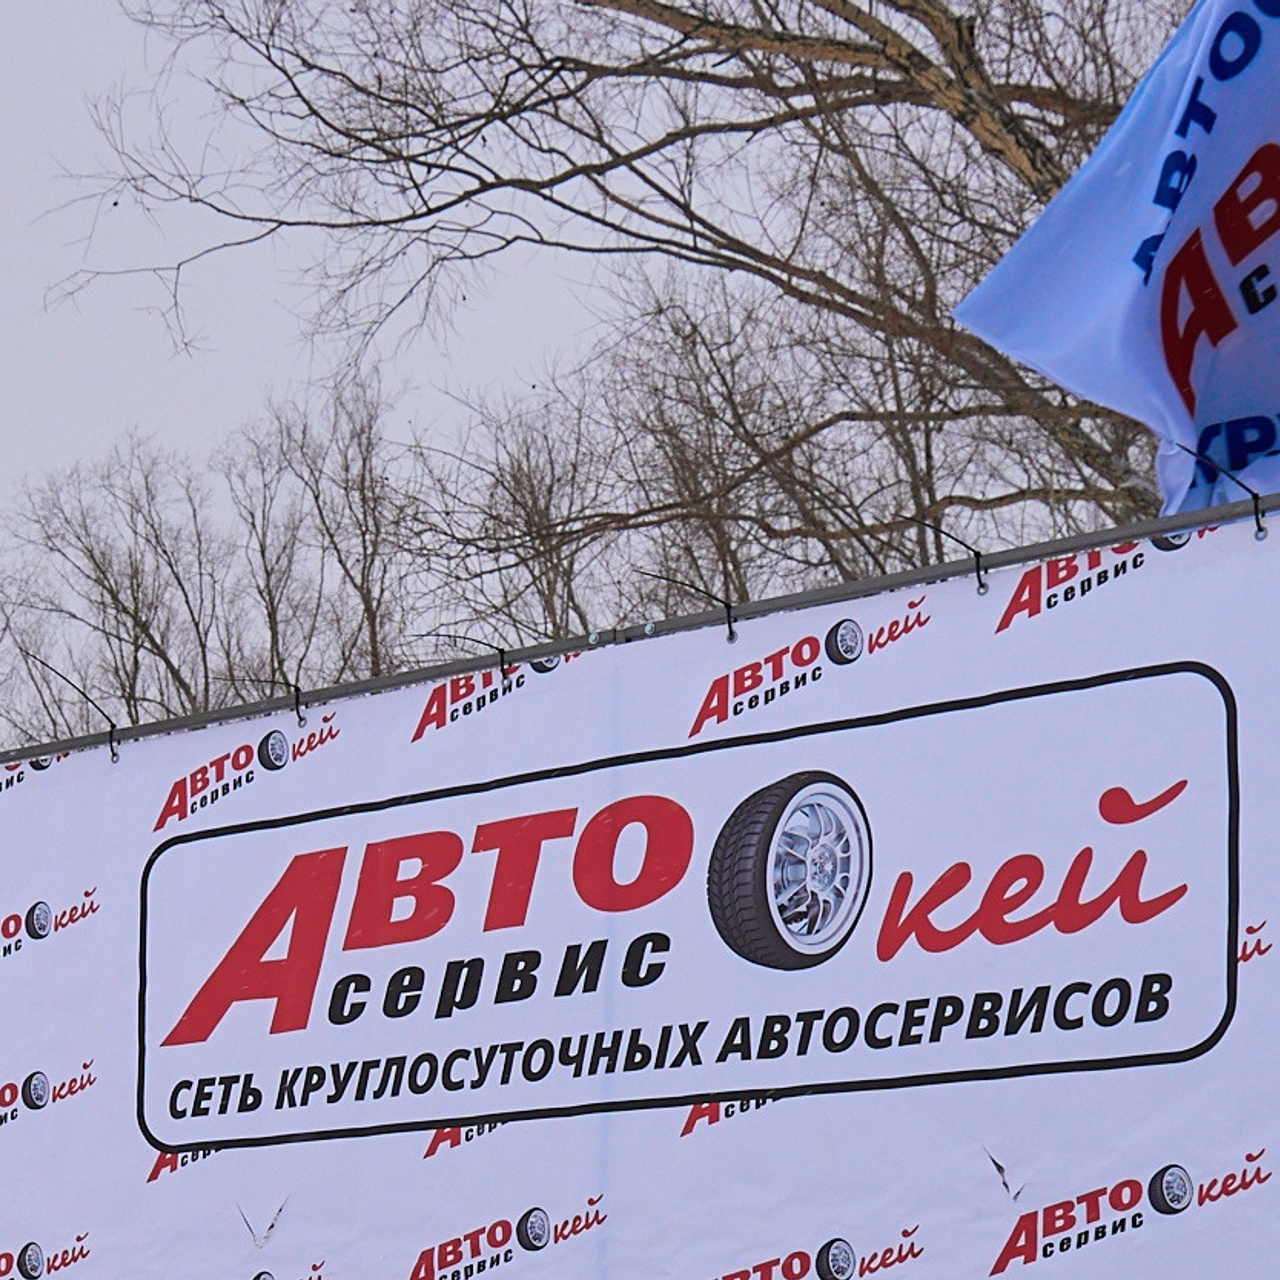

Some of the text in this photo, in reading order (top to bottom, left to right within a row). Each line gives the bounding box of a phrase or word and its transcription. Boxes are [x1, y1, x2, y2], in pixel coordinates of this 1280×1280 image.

[1132, 0, 1280, 287] АВТО
[1045, 551, 1146, 610] сервис
[449, 673, 526, 723] сервис
[689, 635, 821, 738] АВТО
[732, 666, 822, 716] сервис
[153, 744, 255, 832] АВТО
[190, 770, 255, 815] сервис
[160, 794, 695, 1047] АВТО
[328, 931, 671, 1026] сервис
[169, 972, 1173, 1119] СЕТЬ КРУГЛОСУТОЧНЫХ АВТОСЕРВИСОВ
[990, 1179, 1143, 1276] АВТО
[1042, 1212, 1144, 1259] сервис
